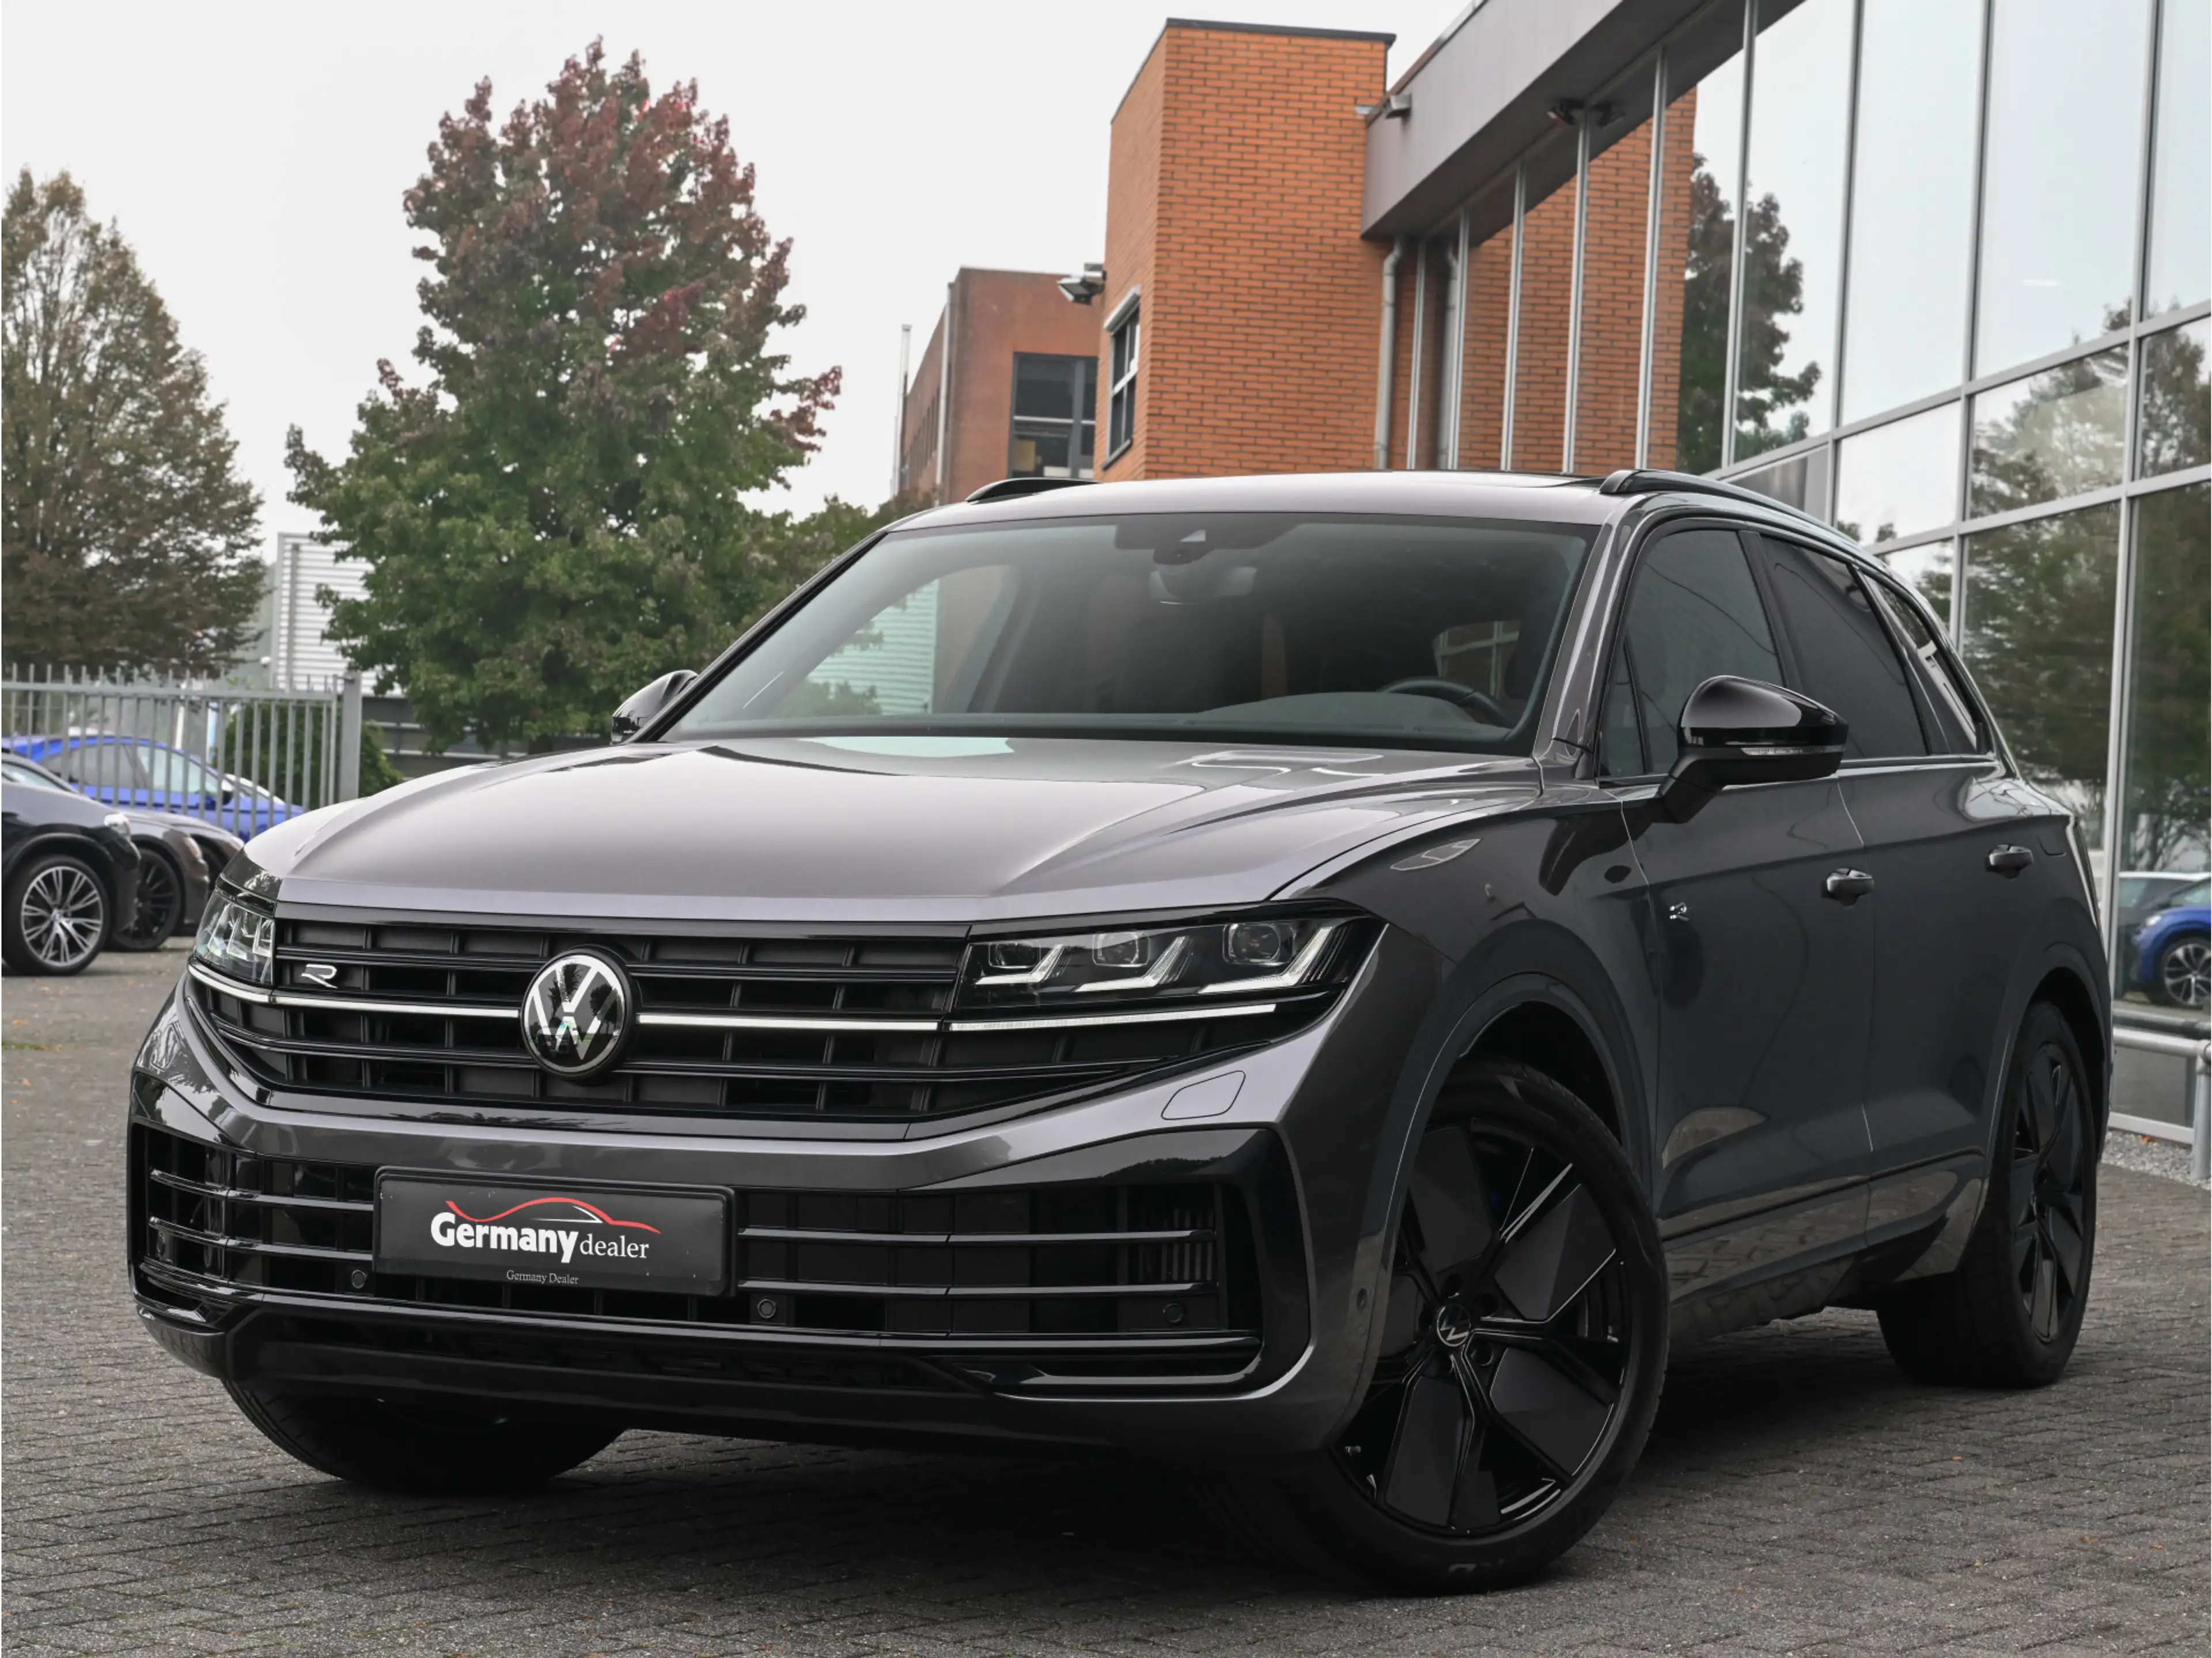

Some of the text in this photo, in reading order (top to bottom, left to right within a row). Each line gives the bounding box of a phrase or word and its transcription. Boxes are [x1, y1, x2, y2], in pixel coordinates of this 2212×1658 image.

[301, 963, 338, 989] R
[430, 1212, 650, 1263] Germany dealer
[506, 1270, 579, 1285] Germany Dealer
